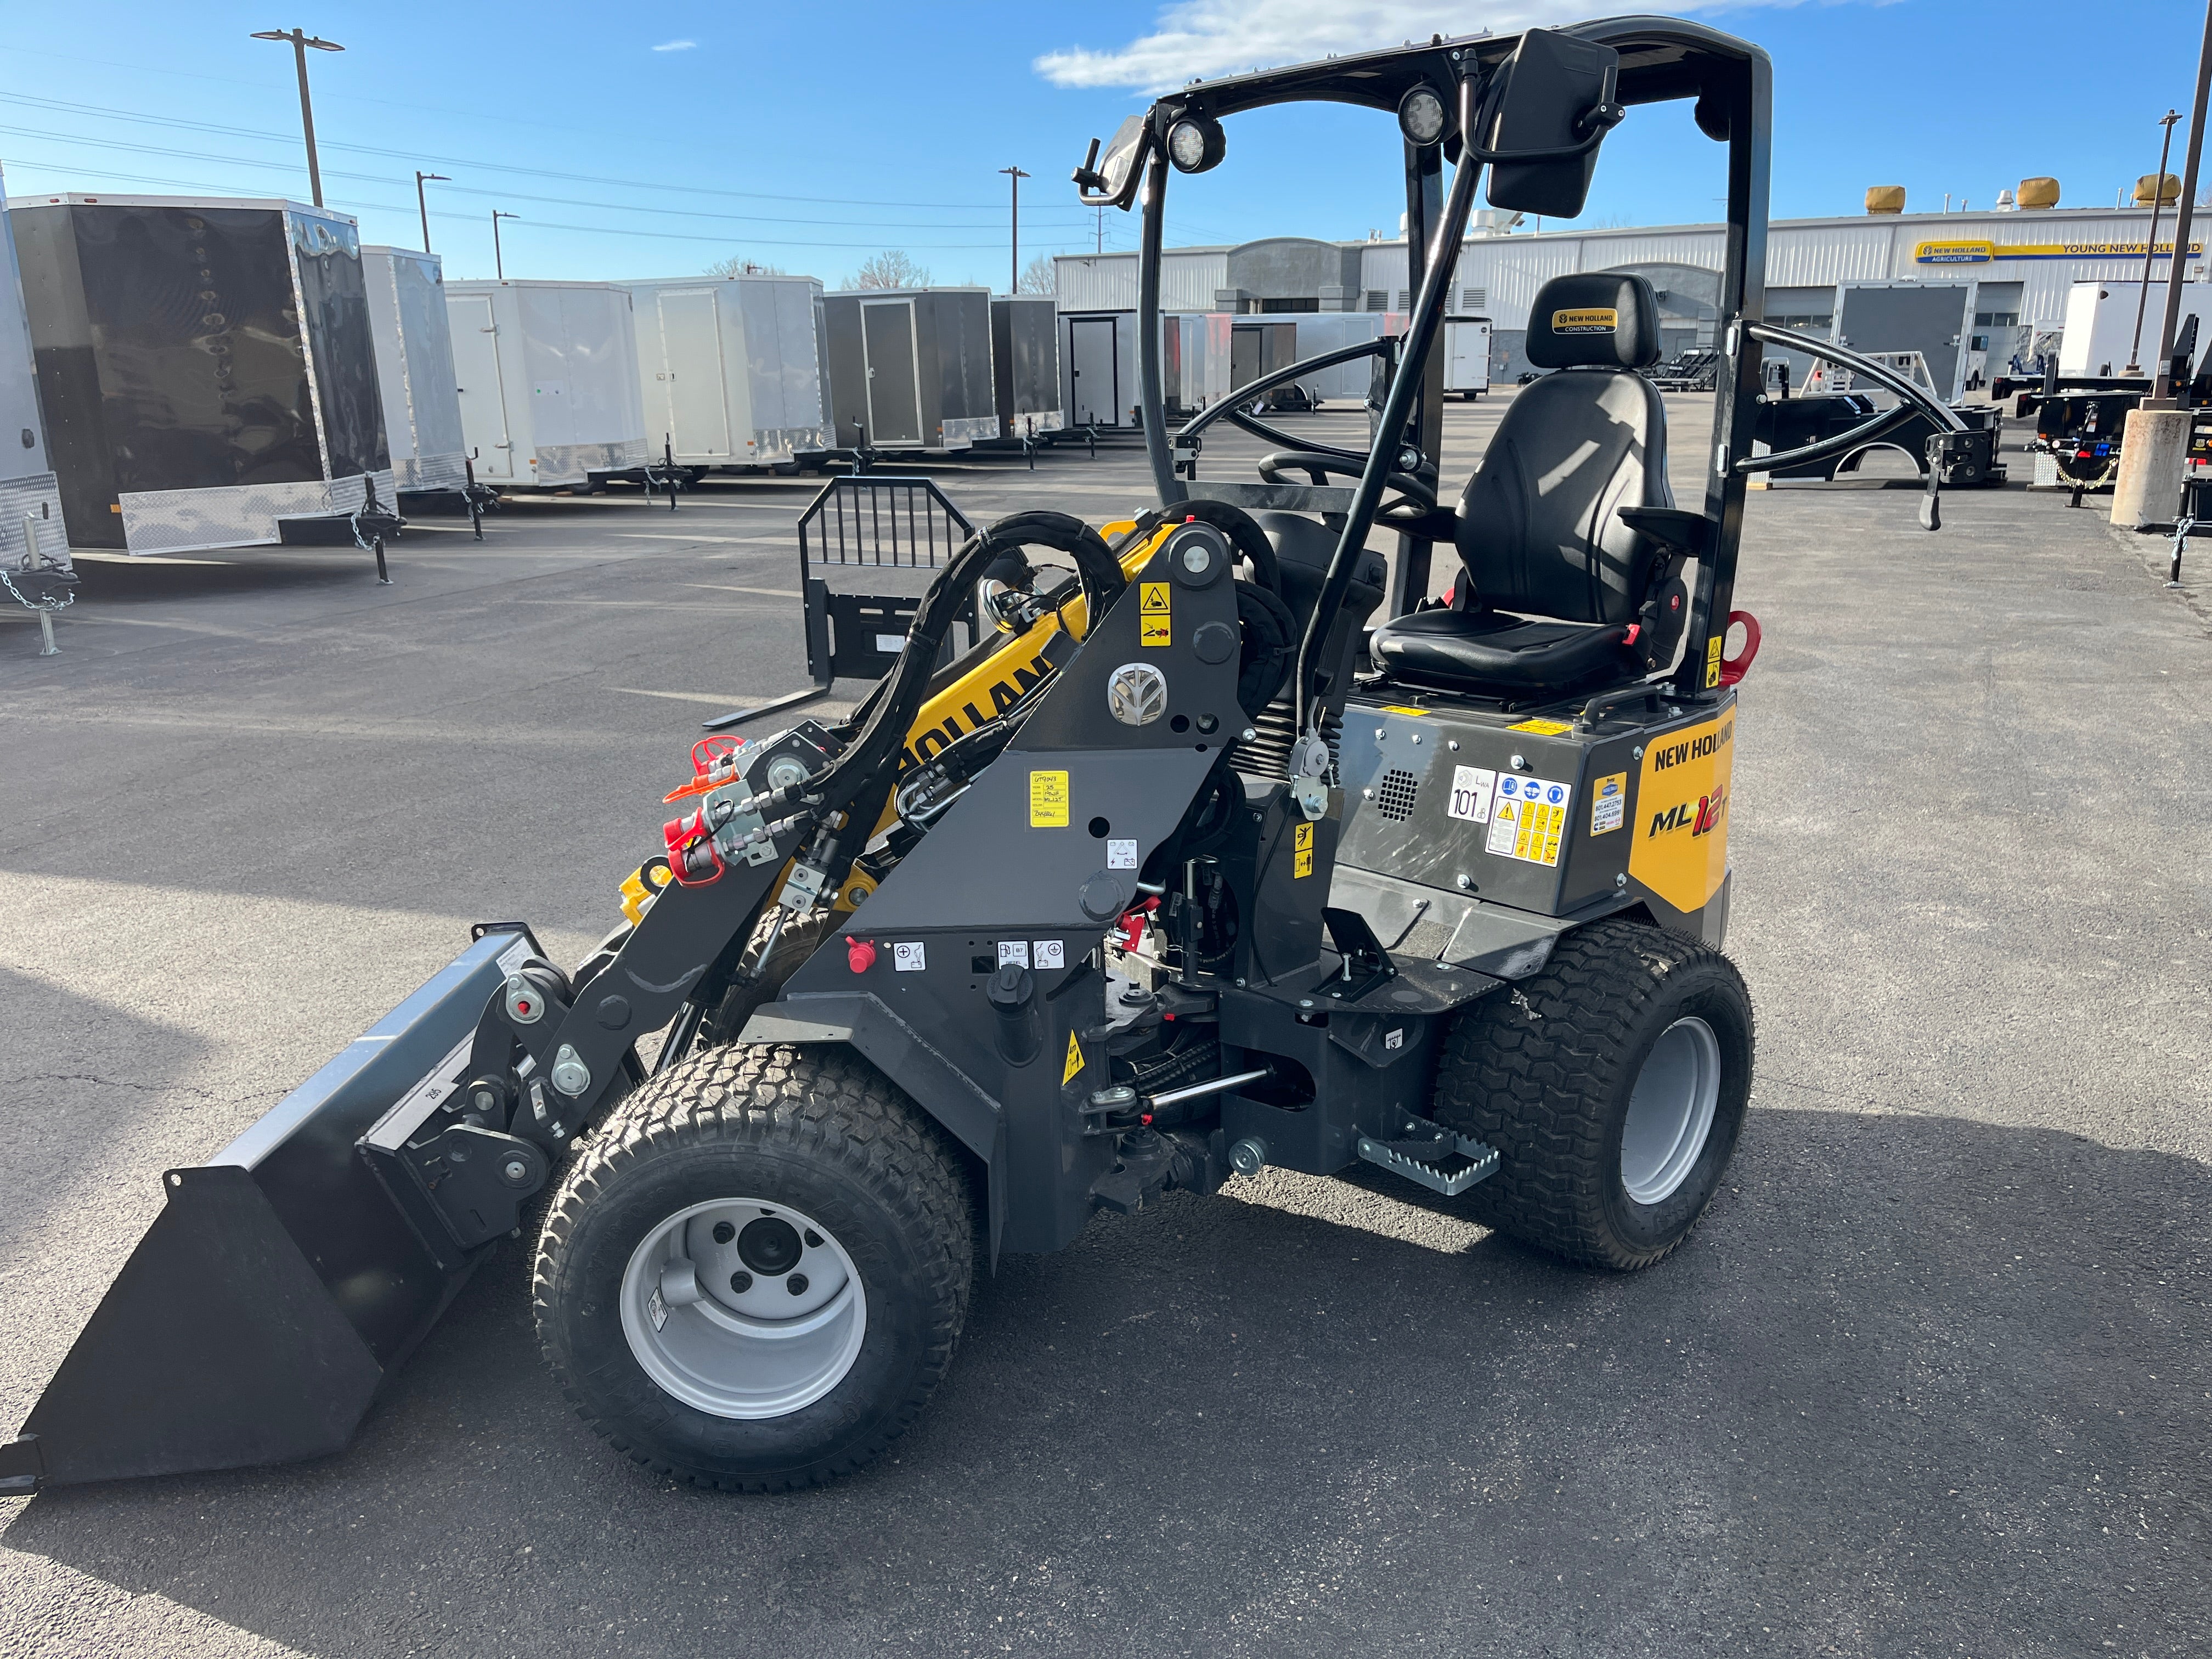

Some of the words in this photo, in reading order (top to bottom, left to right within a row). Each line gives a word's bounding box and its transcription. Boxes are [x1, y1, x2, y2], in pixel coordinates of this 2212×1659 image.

[2063, 245, 2106, 253] YOUNG
[2109, 244, 2138, 252] NEW
[2141, 243, 2200, 252] HOLLD
[1655, 742, 1689, 772] NEW
[1691, 720, 1733, 760] HOLLAND
[1454, 789, 1478, 817] 101
[1477, 808, 1486, 819] dB
[1595, 799, 1622, 812] 801.447.2753
[1069, 1044, 1076, 1054] 4m
[425, 1088, 442, 1099] 295
